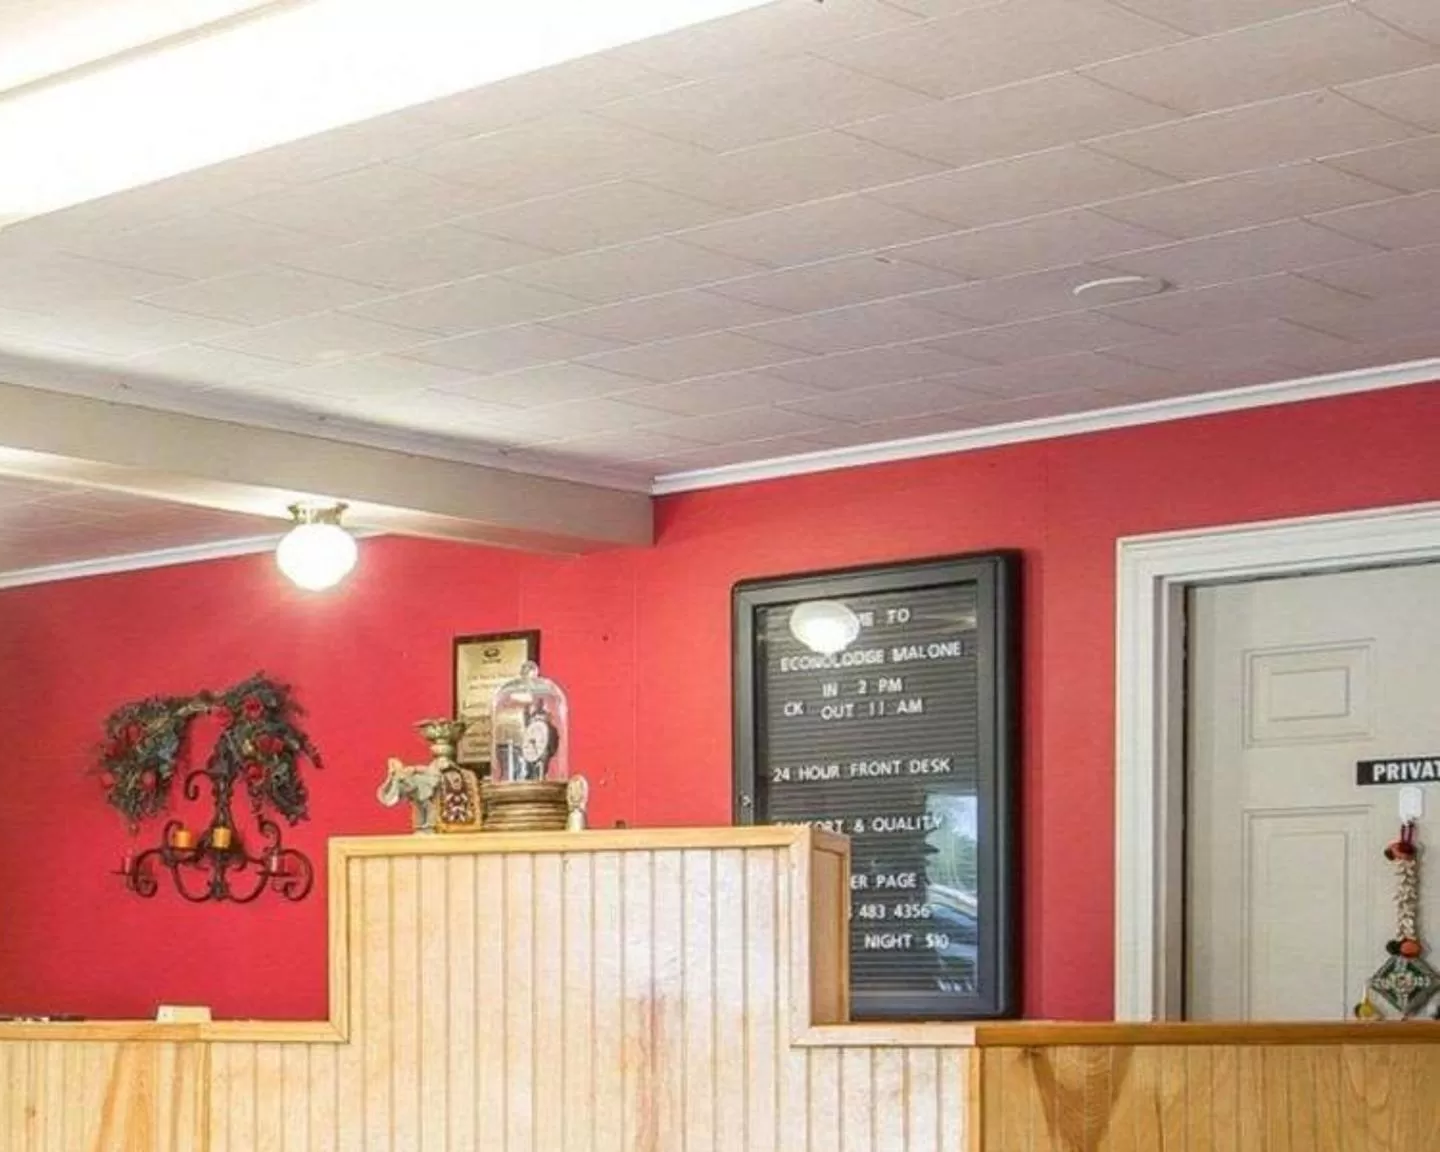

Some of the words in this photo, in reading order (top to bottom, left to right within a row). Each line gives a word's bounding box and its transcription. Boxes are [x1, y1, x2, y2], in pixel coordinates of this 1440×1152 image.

[887, 608, 910, 625] TO
[893, 641, 962, 662] MALONE
[822, 682, 838, 697] IN
[858, 679, 867, 694] 2
[879, 677, 902, 692] PM
[784, 702, 804, 716] CK
[820, 703, 855, 720] OUT
[896, 698, 923, 714] AM
[772, 767, 790, 782] 24
[799, 765, 840, 781] HOUR
[850, 760, 901, 777] FRONT
[910, 758, 951, 774] DESK
[854, 817, 865, 833] &
[872, 815, 942, 832] QUALITY
[850, 875, 868, 889] ER
[877, 872, 916, 888] PAGE
[859, 903, 885, 919] 483
[894, 903, 931, 919] 4356
[864, 933, 913, 949] NIGHT
